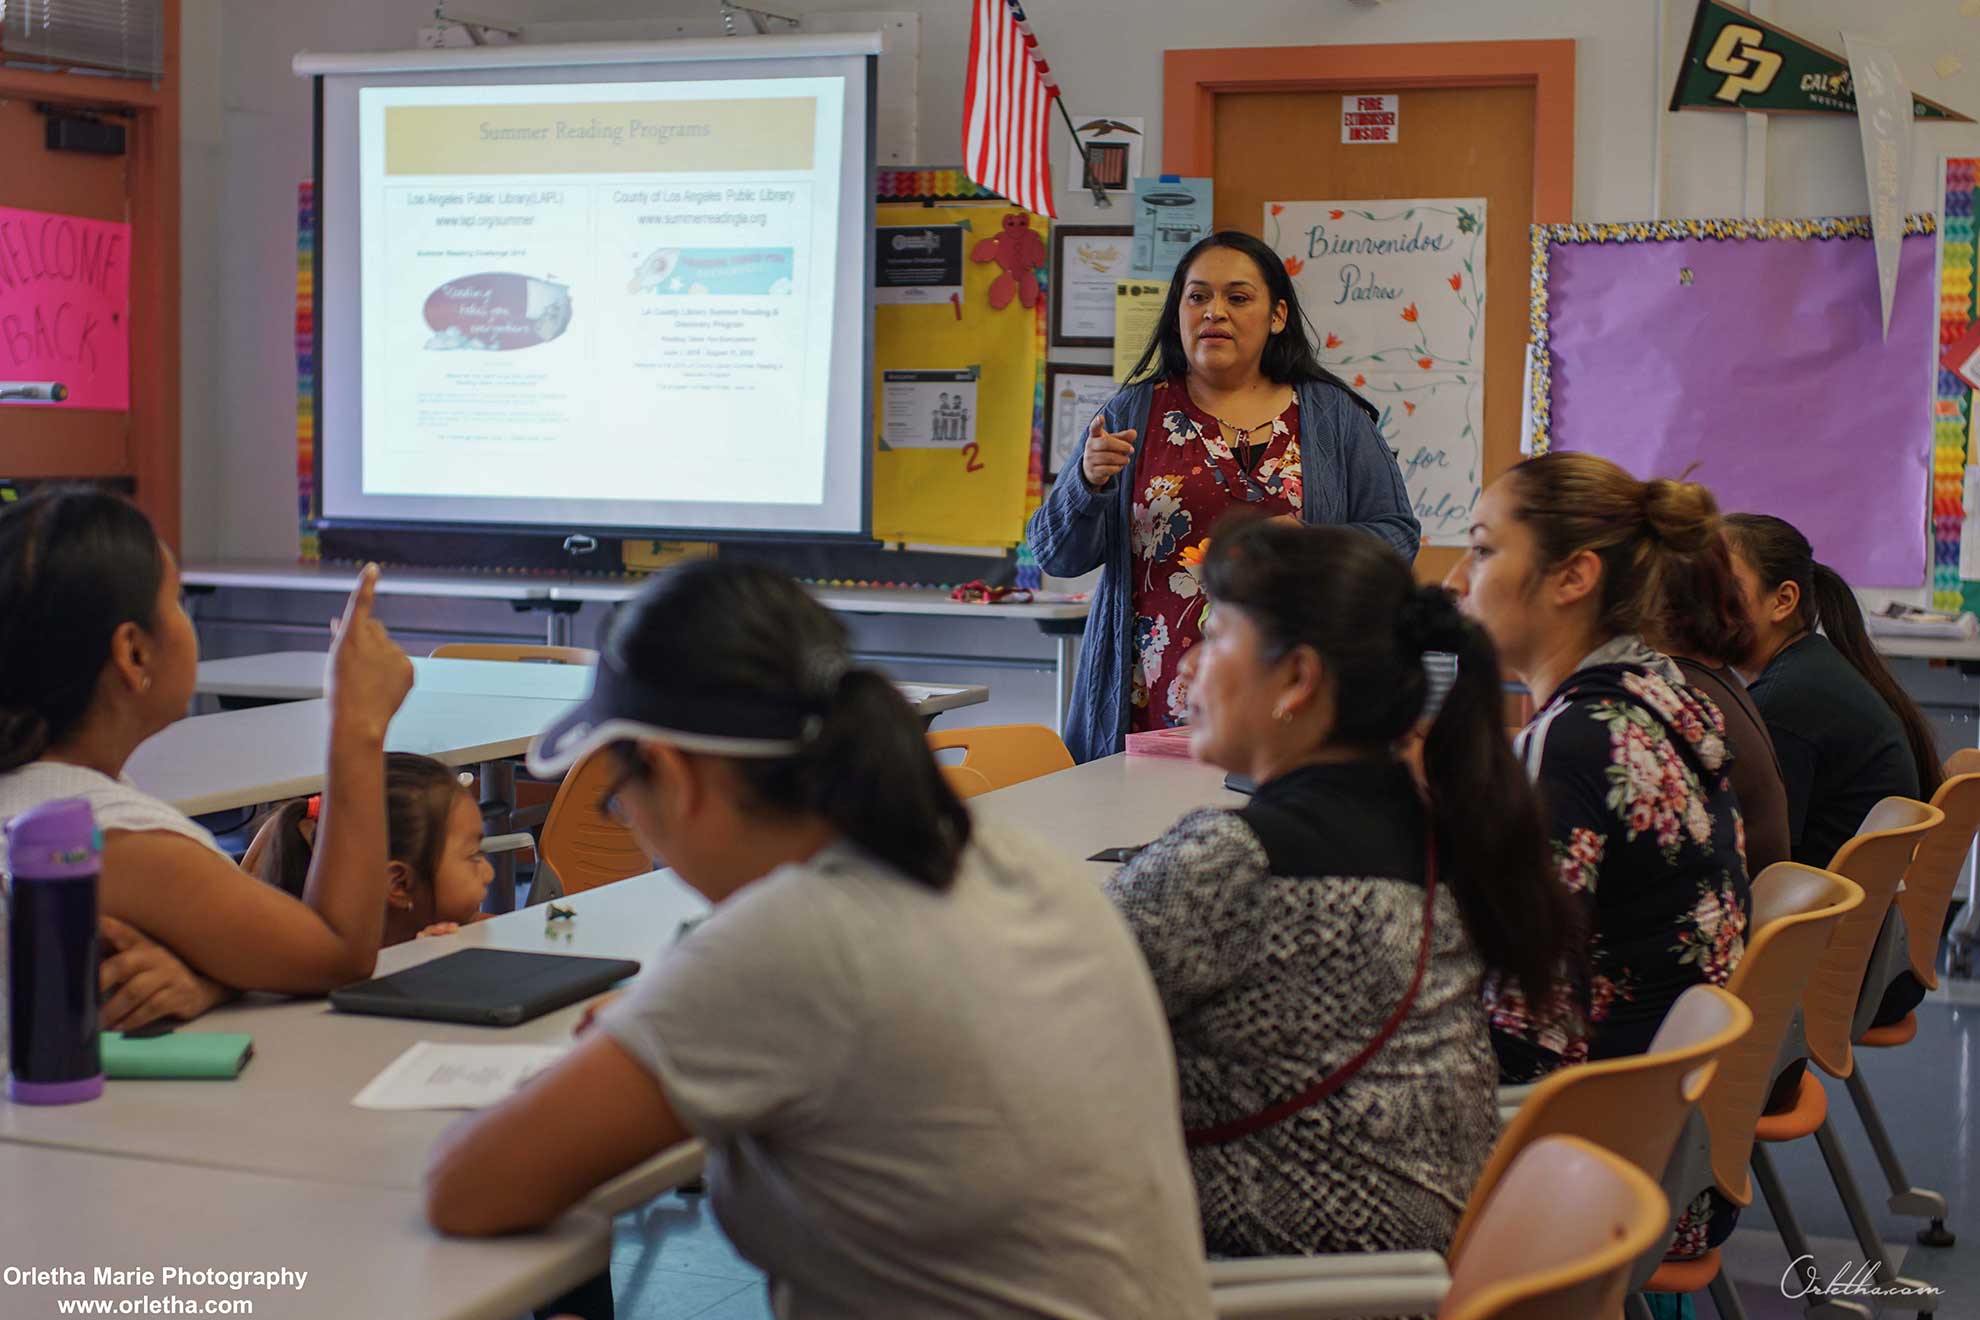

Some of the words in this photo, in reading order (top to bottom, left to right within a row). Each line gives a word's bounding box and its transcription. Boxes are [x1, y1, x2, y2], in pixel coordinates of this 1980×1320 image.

[1705, 23, 1784, 103] CP
[1800, 73, 1829, 92] CAL
[1357, 97, 1384, 111] FIRE
[479, 120, 550, 142] Summer
[555, 117, 624, 146] Reading
[630, 118, 712, 145] Programs
[1350, 127, 1390, 141] INSIDE
[407, 192, 425, 205] Los
[427, 192, 464, 207] Angeles
[467, 192, 495, 205] Public
[612, 190, 649, 205] County
[649, 190, 662, 203] of
[663, 190, 681, 203] Los
[682, 188, 722, 205] Angeles
[726, 188, 756, 203] Public
[759, 188, 795, 205] Library
[1304, 221, 1455, 259] Bienvenidos
[1334, 263, 1404, 305] Padres
[950, 291, 963, 321] 1
[1, 301, 99, 374] BACK
[960, 441, 984, 474] 2
[1404, 446, 1450, 482] for
[1413, 487, 1481, 530] help!
